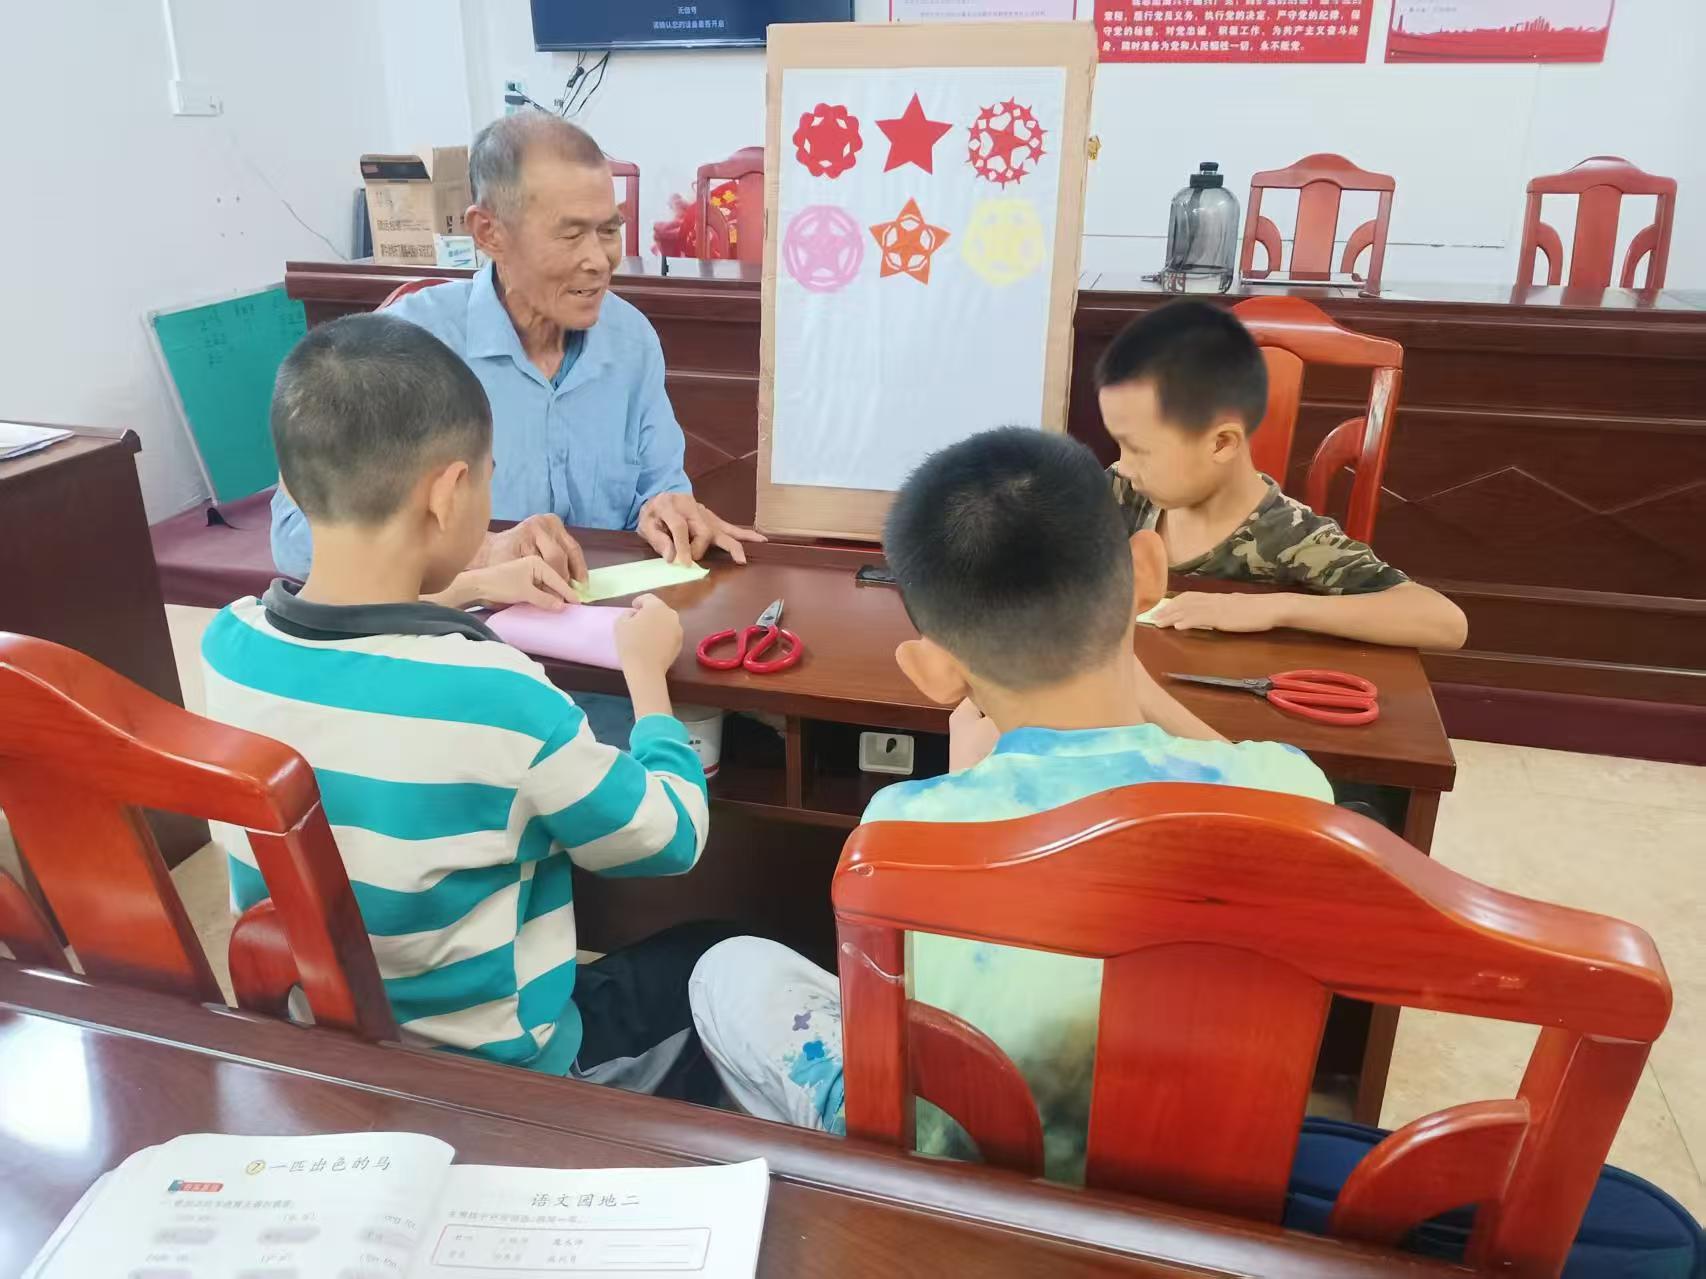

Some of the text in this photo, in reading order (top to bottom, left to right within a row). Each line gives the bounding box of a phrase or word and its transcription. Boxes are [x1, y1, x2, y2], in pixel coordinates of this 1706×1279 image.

[268, 1155, 392, 1173] 一匹出色的马
[530, 1192, 641, 1208] 语文园地二
